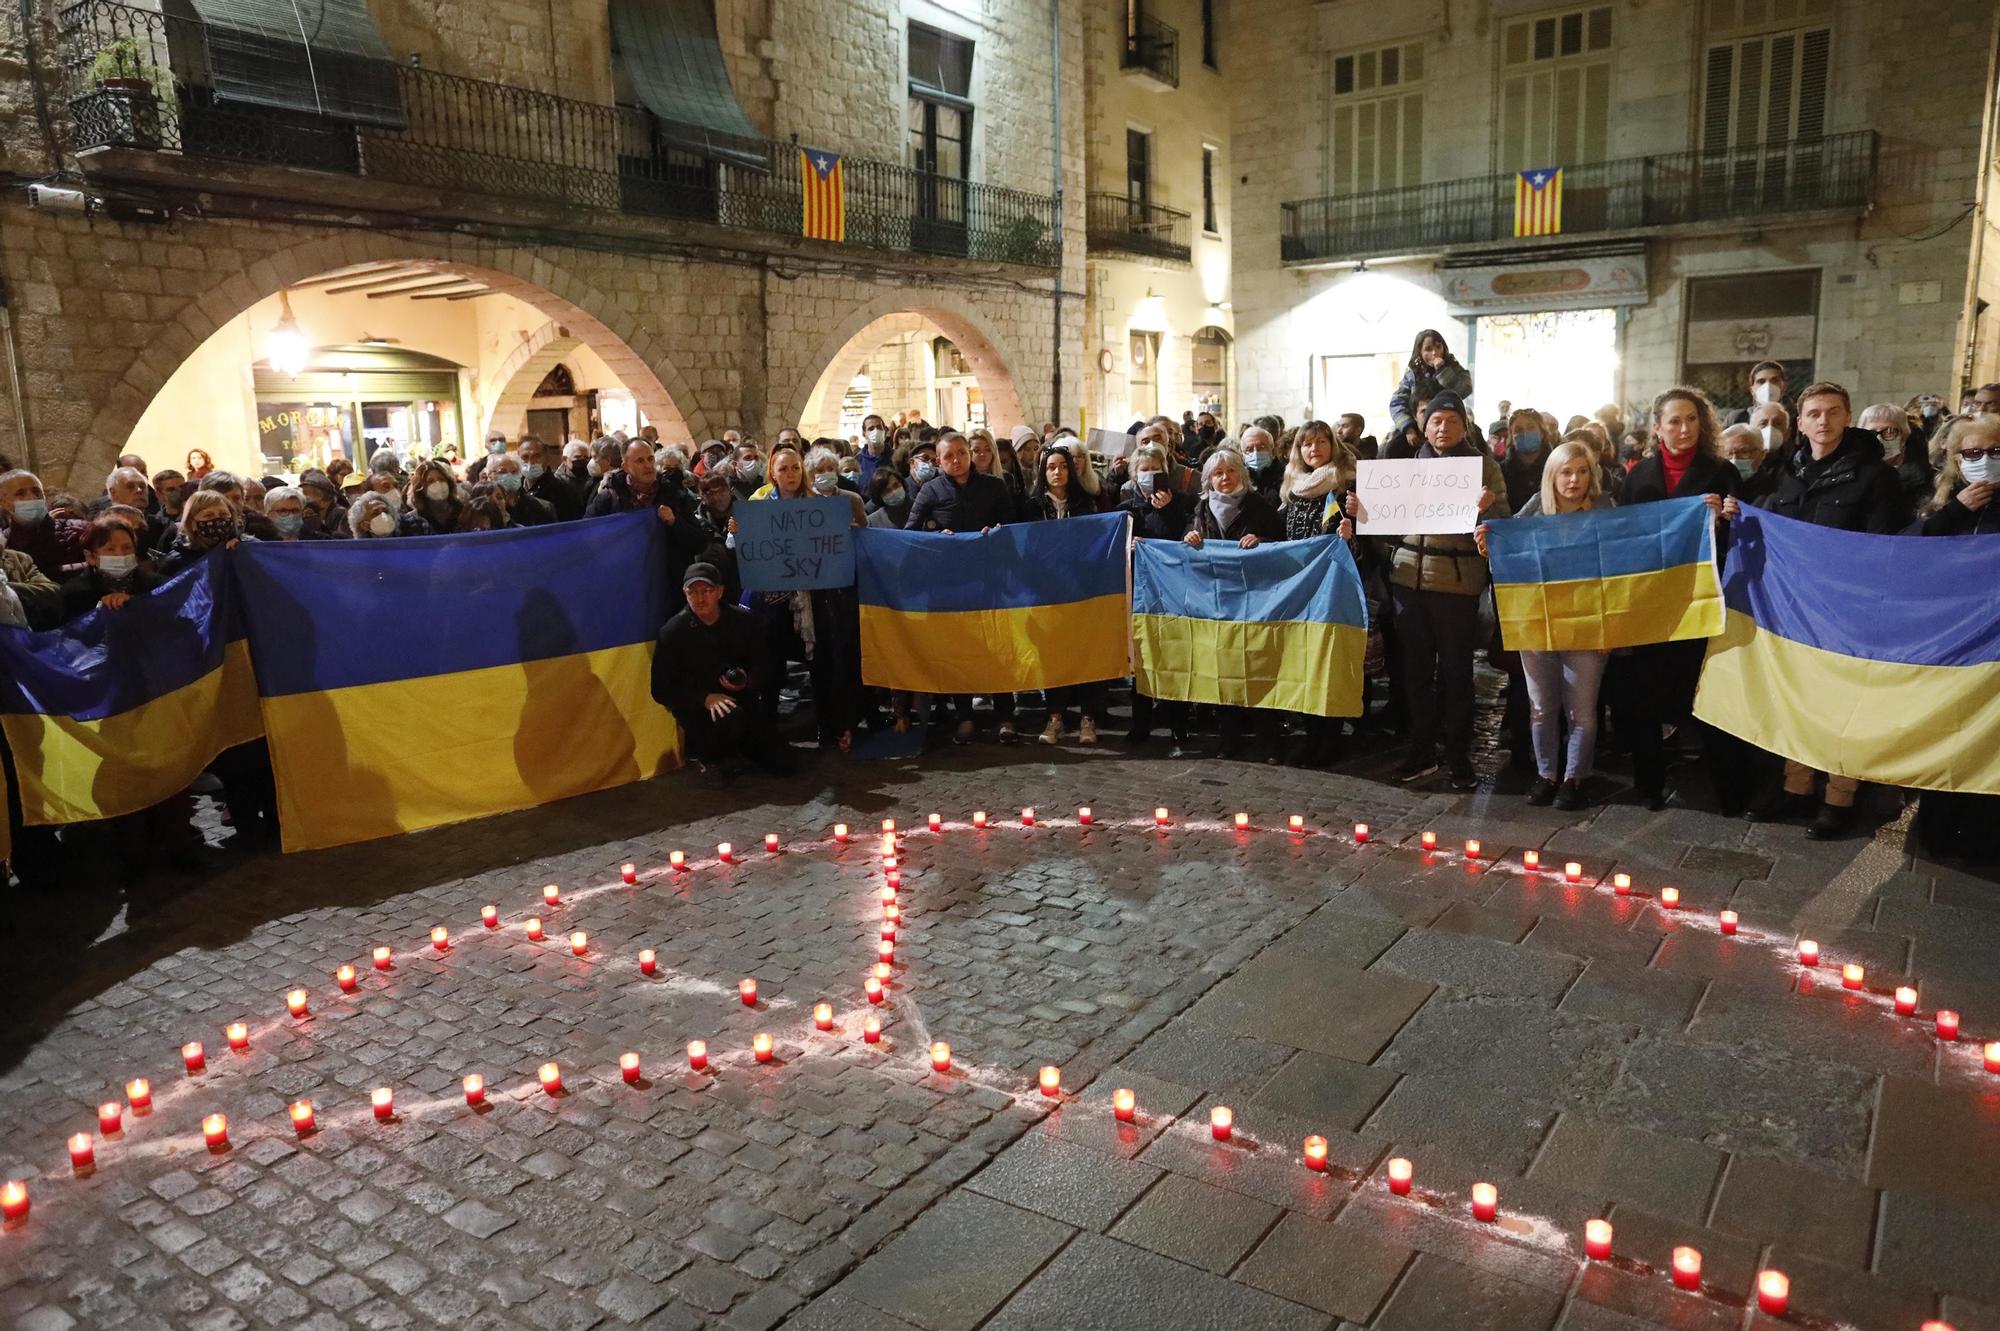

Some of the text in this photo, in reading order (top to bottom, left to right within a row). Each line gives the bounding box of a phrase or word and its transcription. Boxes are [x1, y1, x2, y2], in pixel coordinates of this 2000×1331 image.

[1364, 468, 1473, 490] Los rusos
[770, 508, 825, 534] NATO
[1371, 503, 1407, 521] son
[740, 533, 845, 562] CLOSE THE
[780, 557, 823, 579] SKY
